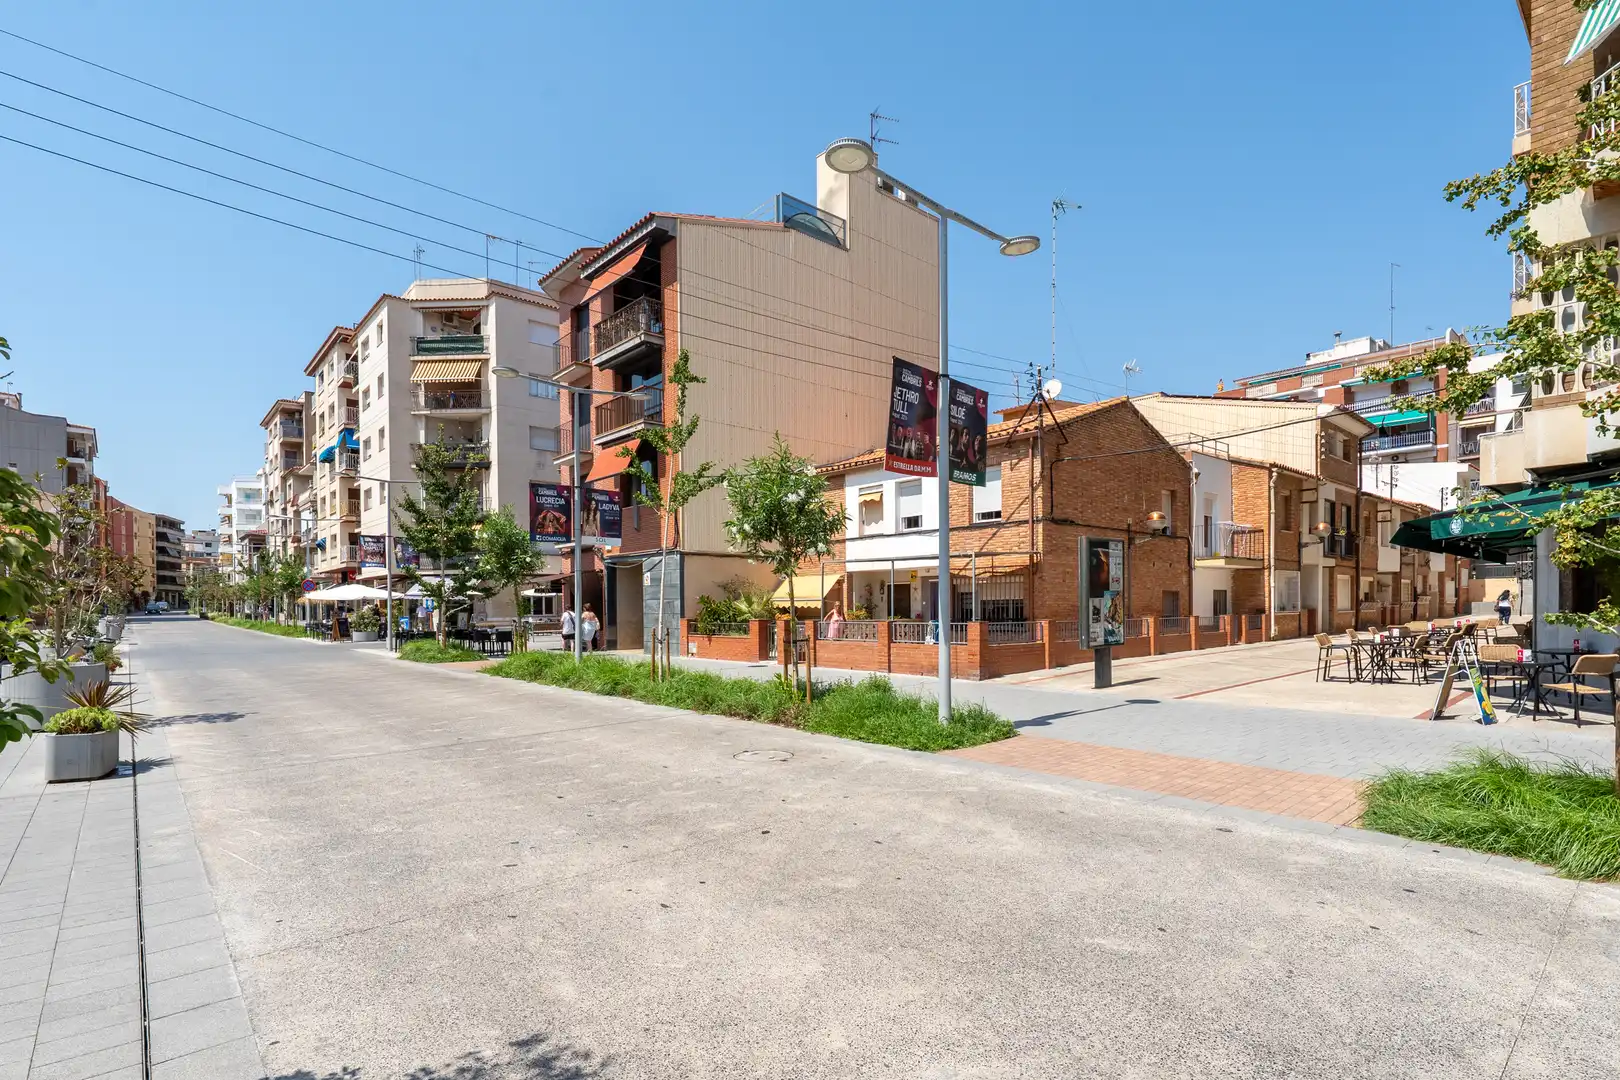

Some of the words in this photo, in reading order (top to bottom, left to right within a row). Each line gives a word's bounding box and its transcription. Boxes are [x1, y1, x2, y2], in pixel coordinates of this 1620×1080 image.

[893, 386, 920, 404] JETHRO
[893, 398, 909, 414] TULL
[950, 404, 967, 420] SILOÉ
[893, 461, 914, 472] ESTRELLA
[914, 464, 932, 473] DAMM
[536, 496, 566, 504] LUCRECIA
[598, 503, 620, 511] LADYVA
